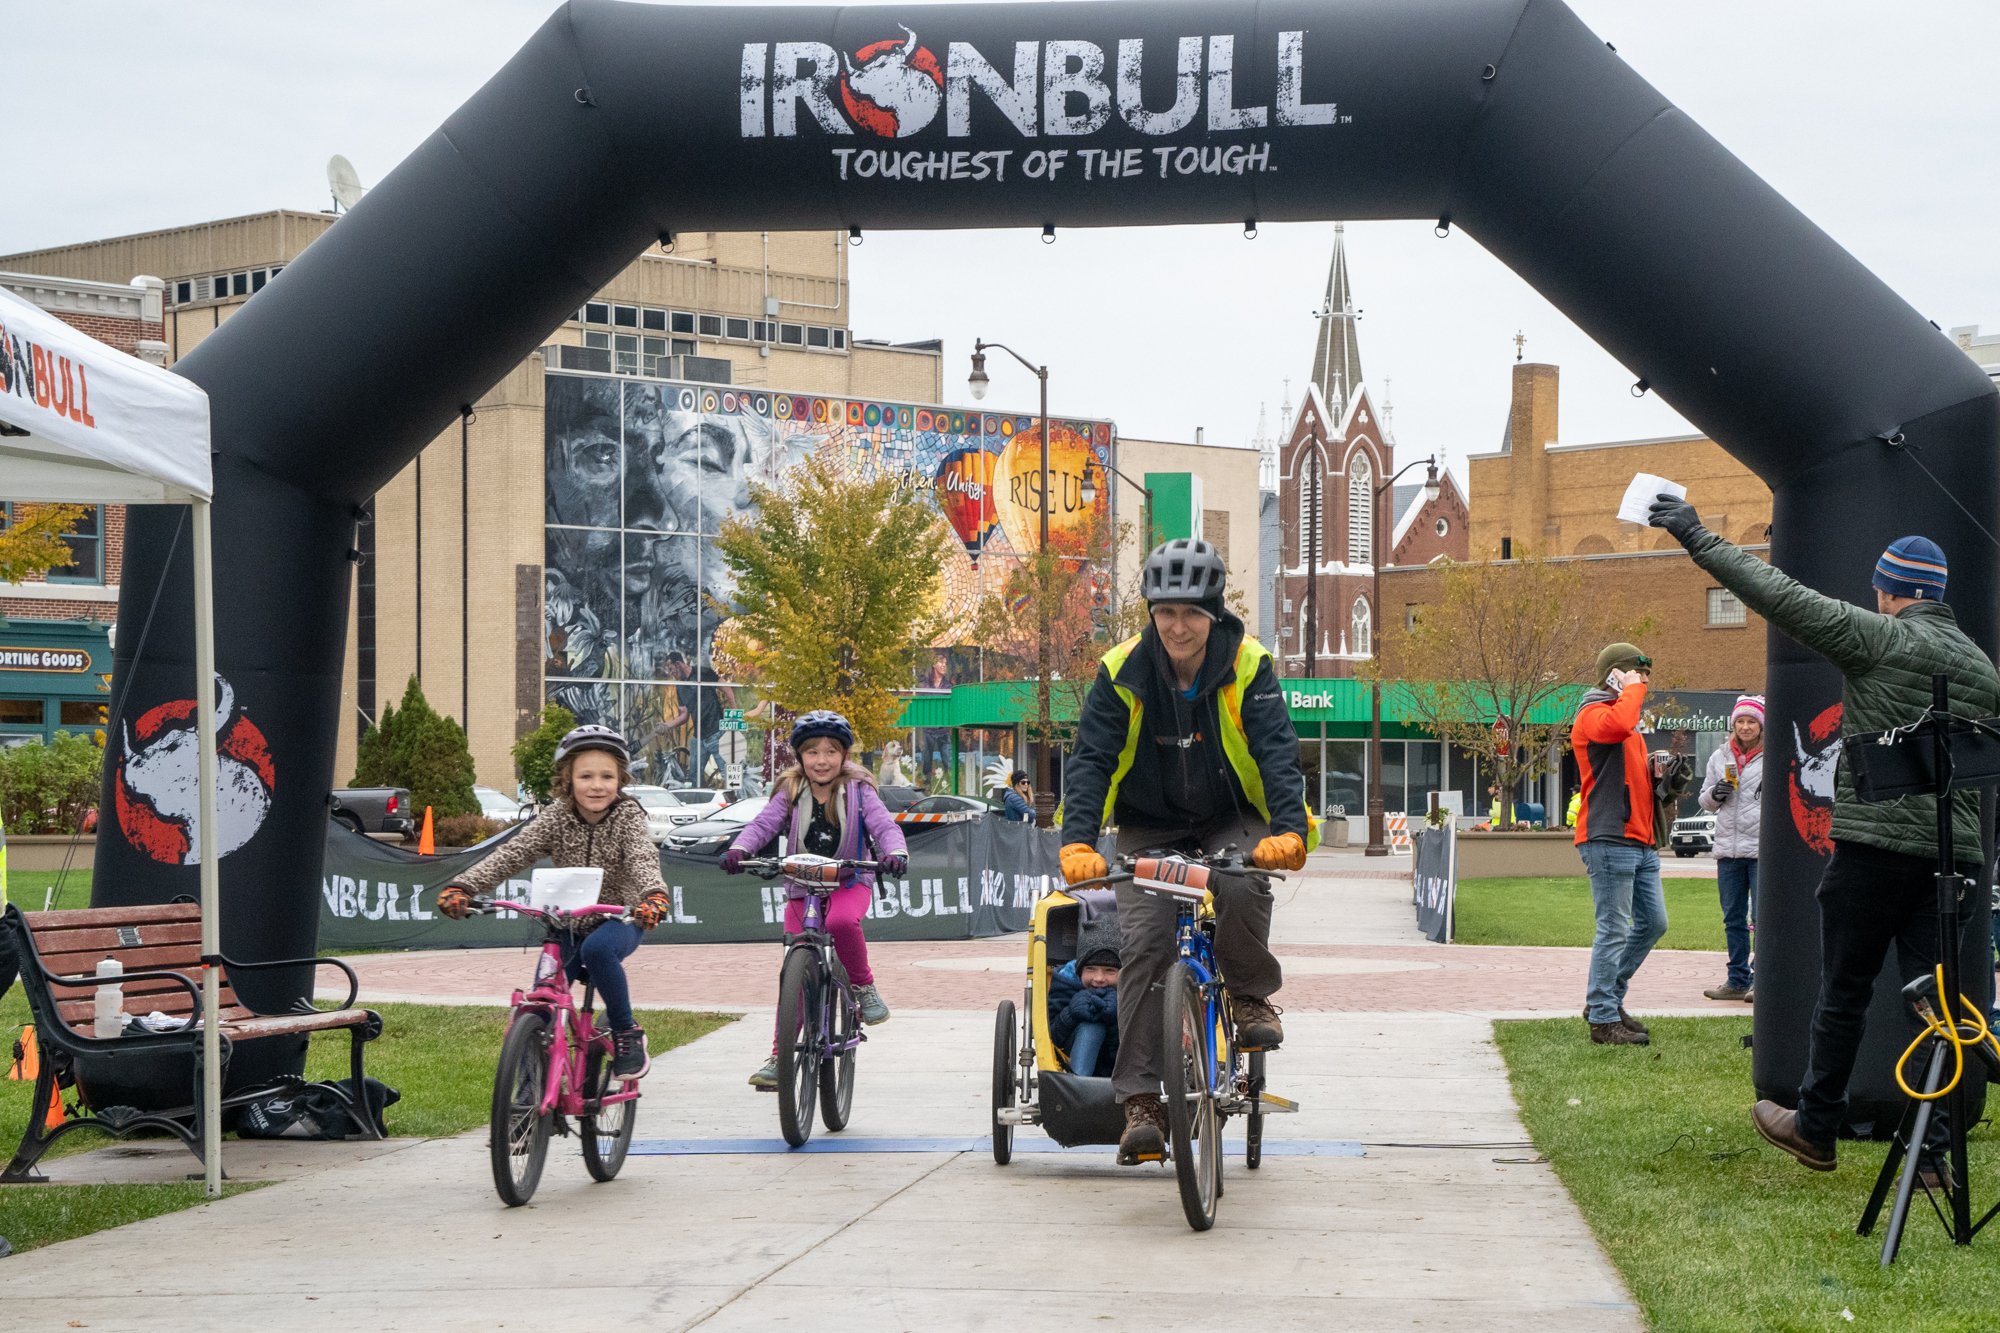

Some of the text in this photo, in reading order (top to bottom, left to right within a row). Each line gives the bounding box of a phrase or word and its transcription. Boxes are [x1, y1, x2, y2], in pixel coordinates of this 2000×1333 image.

[741, 24, 1338, 138] IRONBULL
[832, 148, 1013, 181] TOUGHEST
[1022, 149, 1068, 181] OF
[1076, 147, 1143, 180] THE
[1152, 142, 1270, 178] TOUGH
[1009, 469, 1056, 514] RISE
[42, 652, 83, 667] GOODS
[1291, 690, 1334, 708] Bank
[1657, 715, 1726, 731] Associated
[1153, 859, 1188, 885] 170
[250, 1102, 270, 1130] STRIKE
